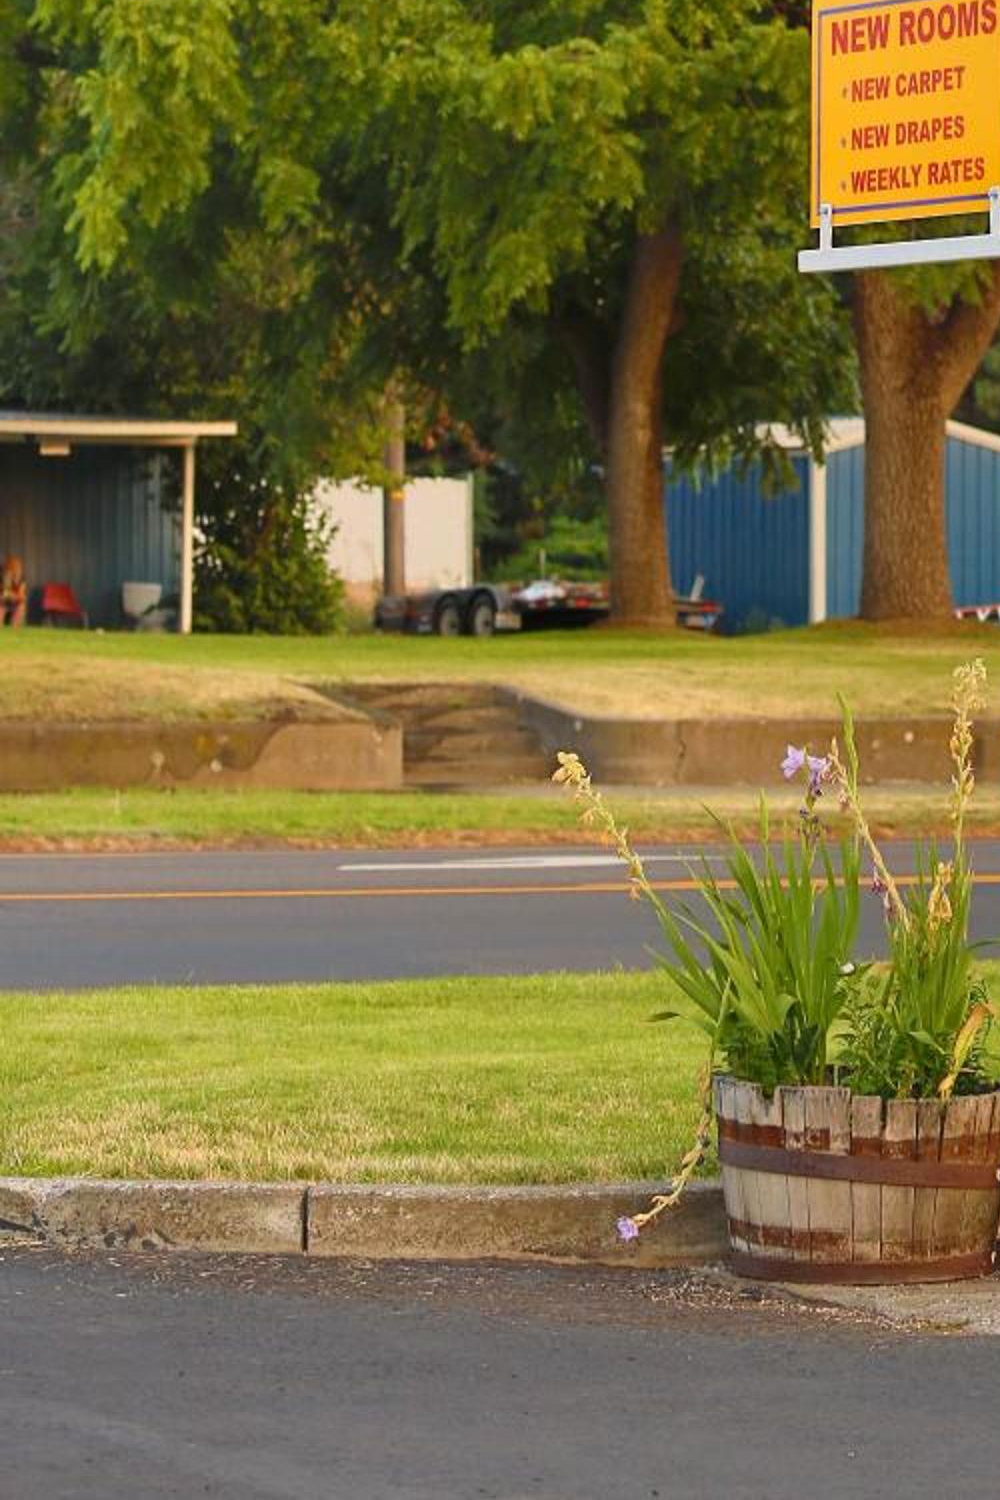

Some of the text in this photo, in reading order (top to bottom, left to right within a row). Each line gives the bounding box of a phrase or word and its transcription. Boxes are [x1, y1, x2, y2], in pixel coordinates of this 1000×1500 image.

[831, 14, 890, 56] NEW
[851, 66, 966, 102] NEW CARPET
[851, 116, 965, 150] NEW DRAPES
[851, 157, 985, 194] WEEKLY RATES
